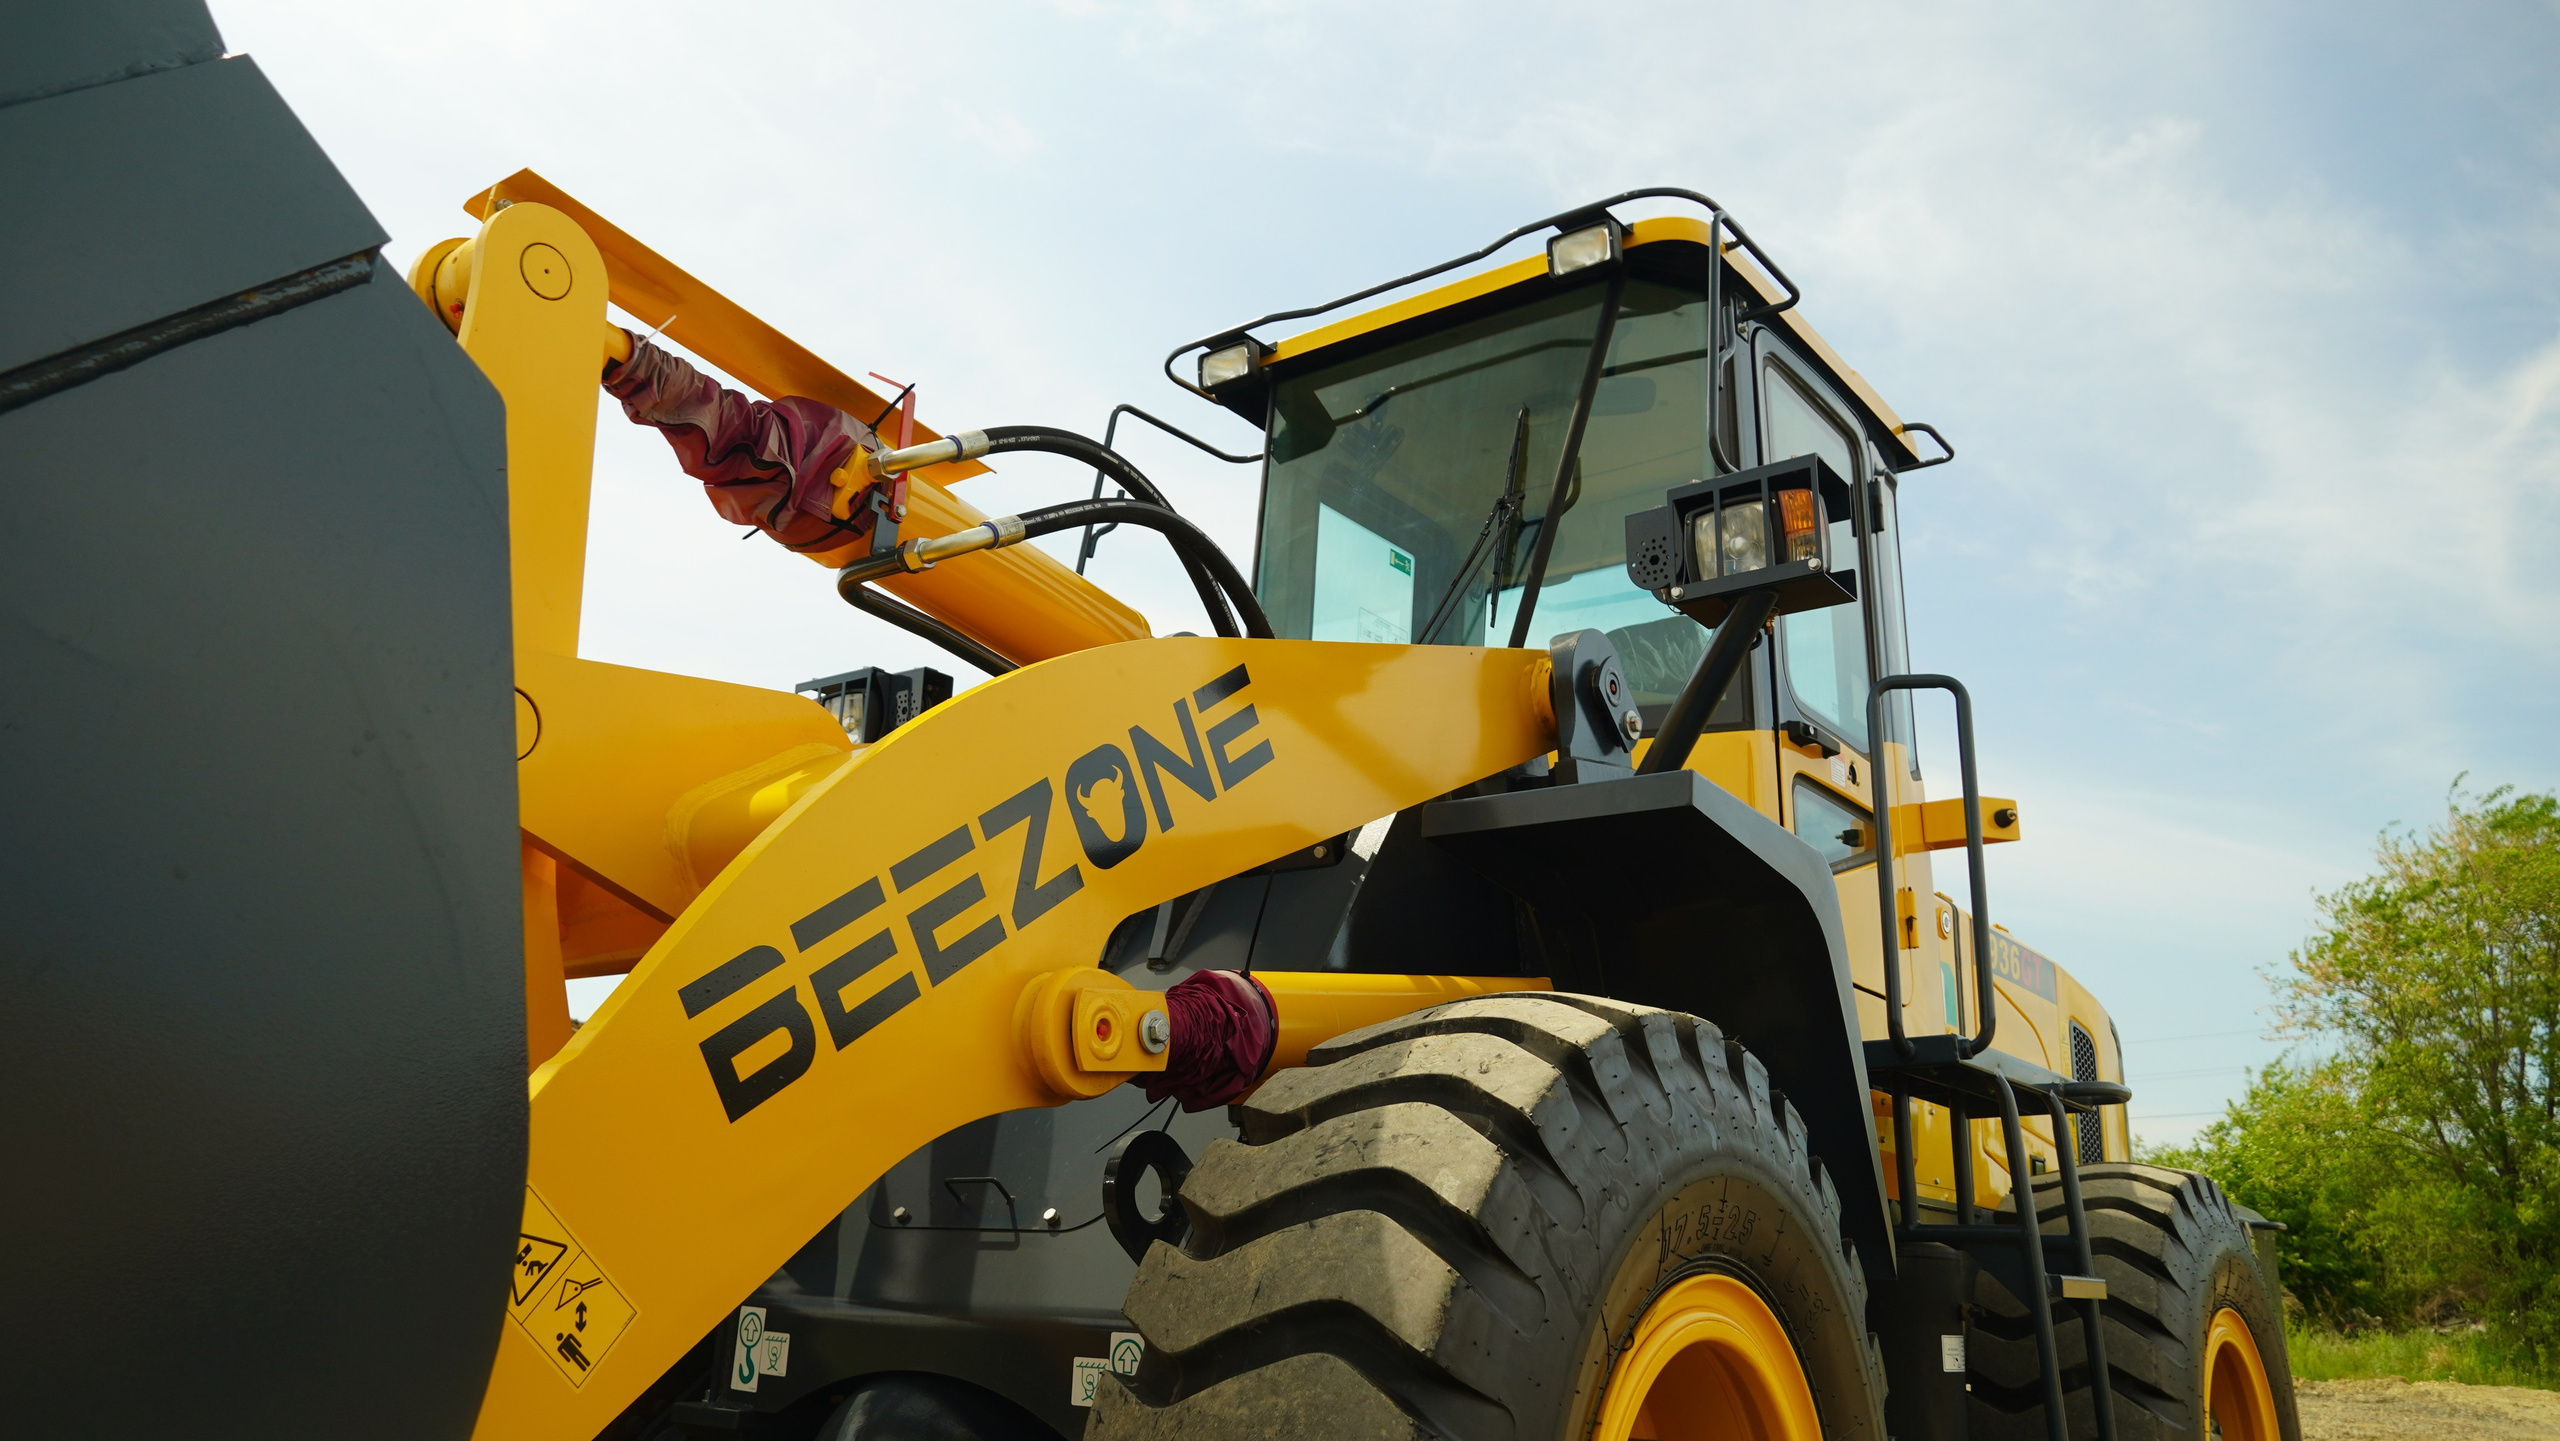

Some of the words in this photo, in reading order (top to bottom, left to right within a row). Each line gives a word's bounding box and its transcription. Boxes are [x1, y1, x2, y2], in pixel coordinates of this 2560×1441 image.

[678, 663, 1275, 1124] BEEZONE
[1989, 933, 2043, 991] 936GT
[1663, 1204, 1757, 1263] 17.5-25
